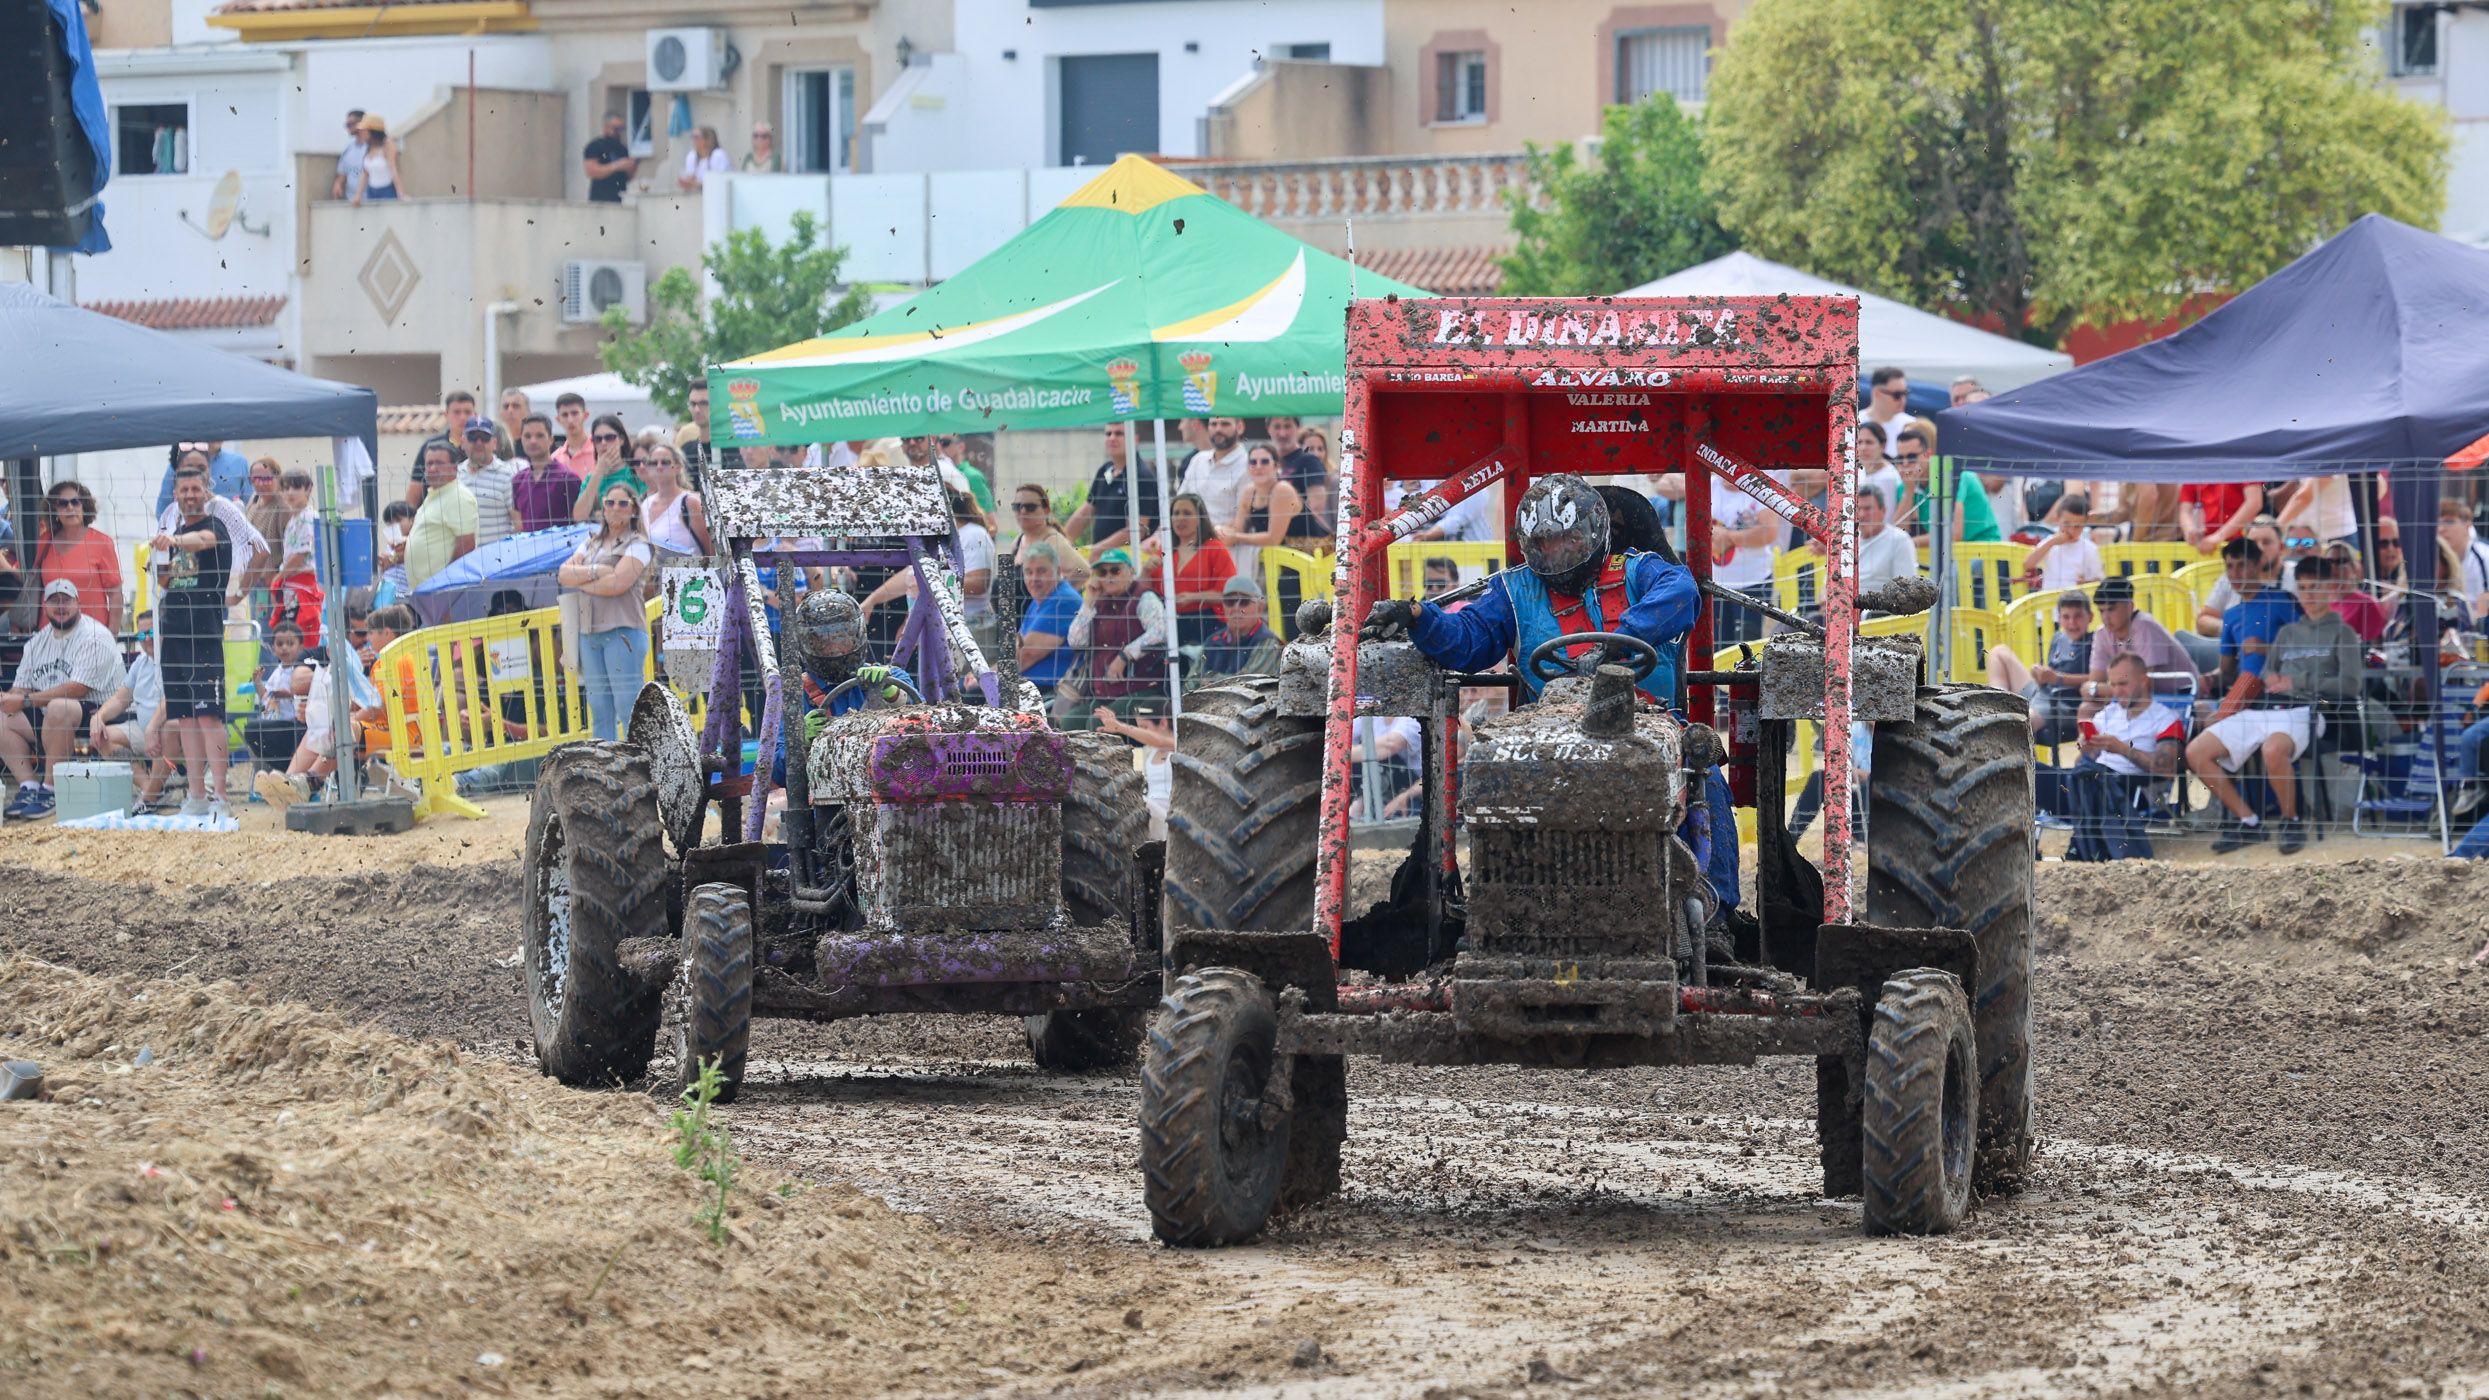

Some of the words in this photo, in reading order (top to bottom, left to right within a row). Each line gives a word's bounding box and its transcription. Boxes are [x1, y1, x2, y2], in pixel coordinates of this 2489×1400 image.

[1433, 309, 1494, 346] EL
[1503, 307, 1741, 347] DINAMITA
[1235, 370, 1346, 402] Ayuntamie
[1531, 371, 1672, 387] ALVARO
[779, 391, 923, 427] Ayuntamiento
[926, 388, 952, 413] de
[1566, 393, 1651, 406] VALERIA
[1570, 420, 1650, 433] MARTINA
[679, 578, 707, 625] 6
